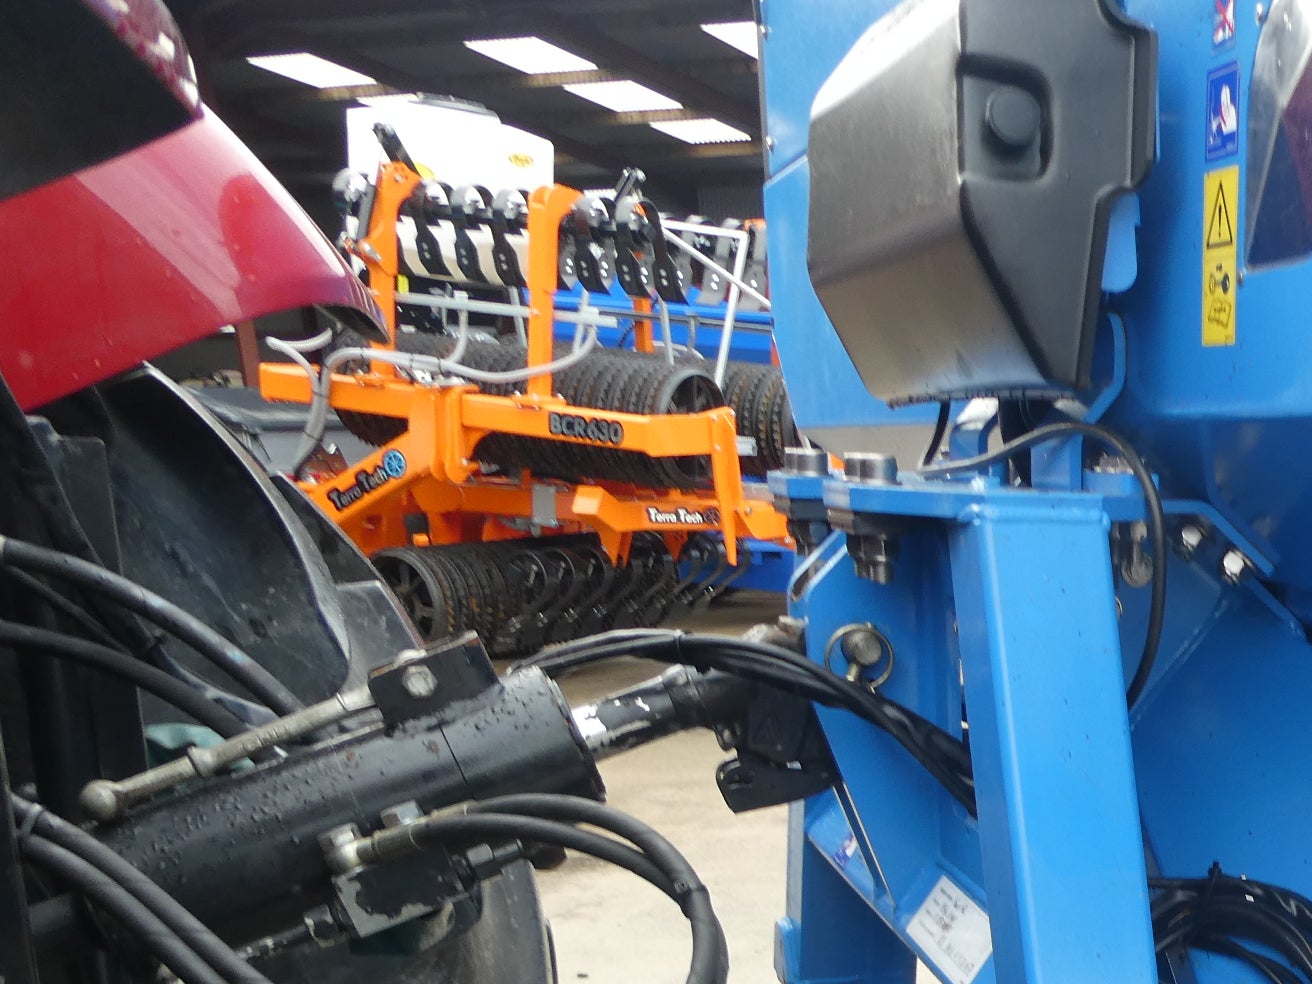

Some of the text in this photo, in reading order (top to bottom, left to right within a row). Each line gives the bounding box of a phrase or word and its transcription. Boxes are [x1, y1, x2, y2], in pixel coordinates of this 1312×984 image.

[327, 466, 390, 511] Terra Tech
[647, 506, 704, 524] Terra Tech
